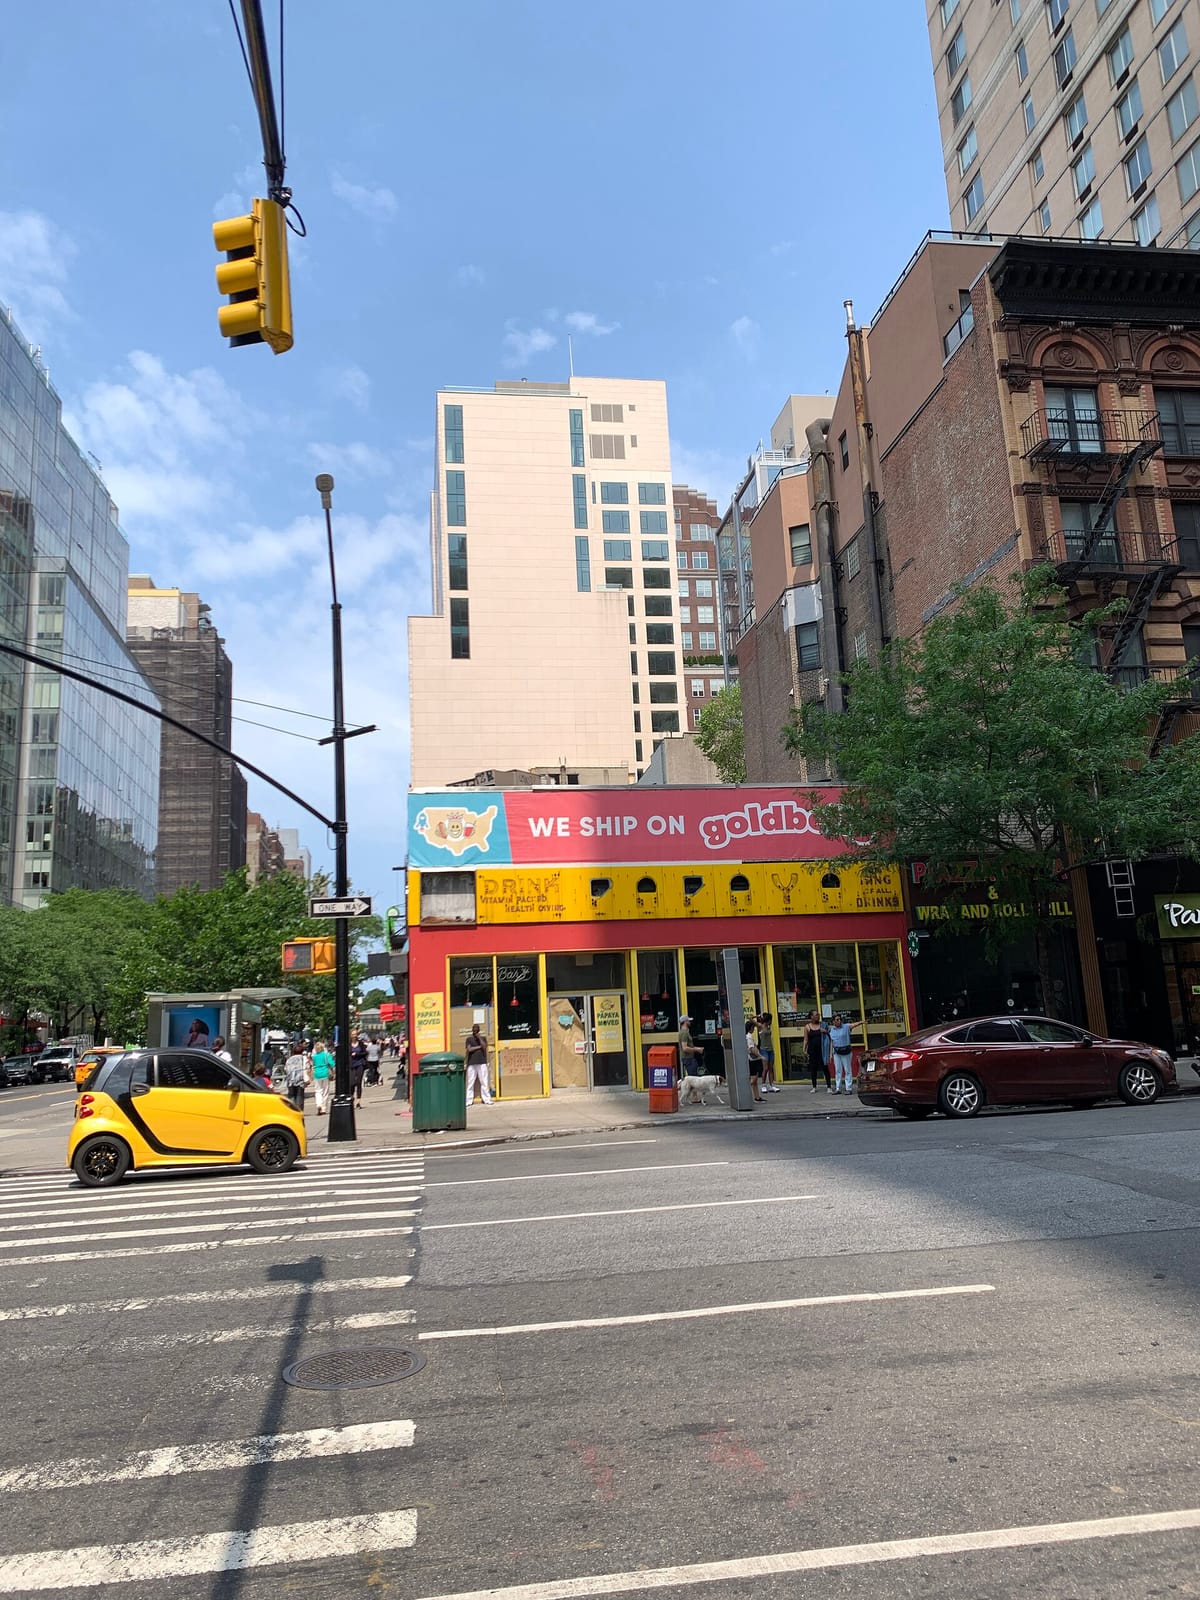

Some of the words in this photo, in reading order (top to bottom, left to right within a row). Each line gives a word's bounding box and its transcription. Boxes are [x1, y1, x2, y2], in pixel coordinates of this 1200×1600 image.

[528, 817, 570, 837] WE
[579, 816, 637, 837] SHIP
[647, 815, 685, 836] ON
[483, 878, 560, 895] DRINK
[987, 885, 999, 900] &
[318, 903, 336, 912] ONE
[344, 903, 362, 911] WAY
[915, 904, 956, 920] WRA
[961, 903, 990, 919] AND
